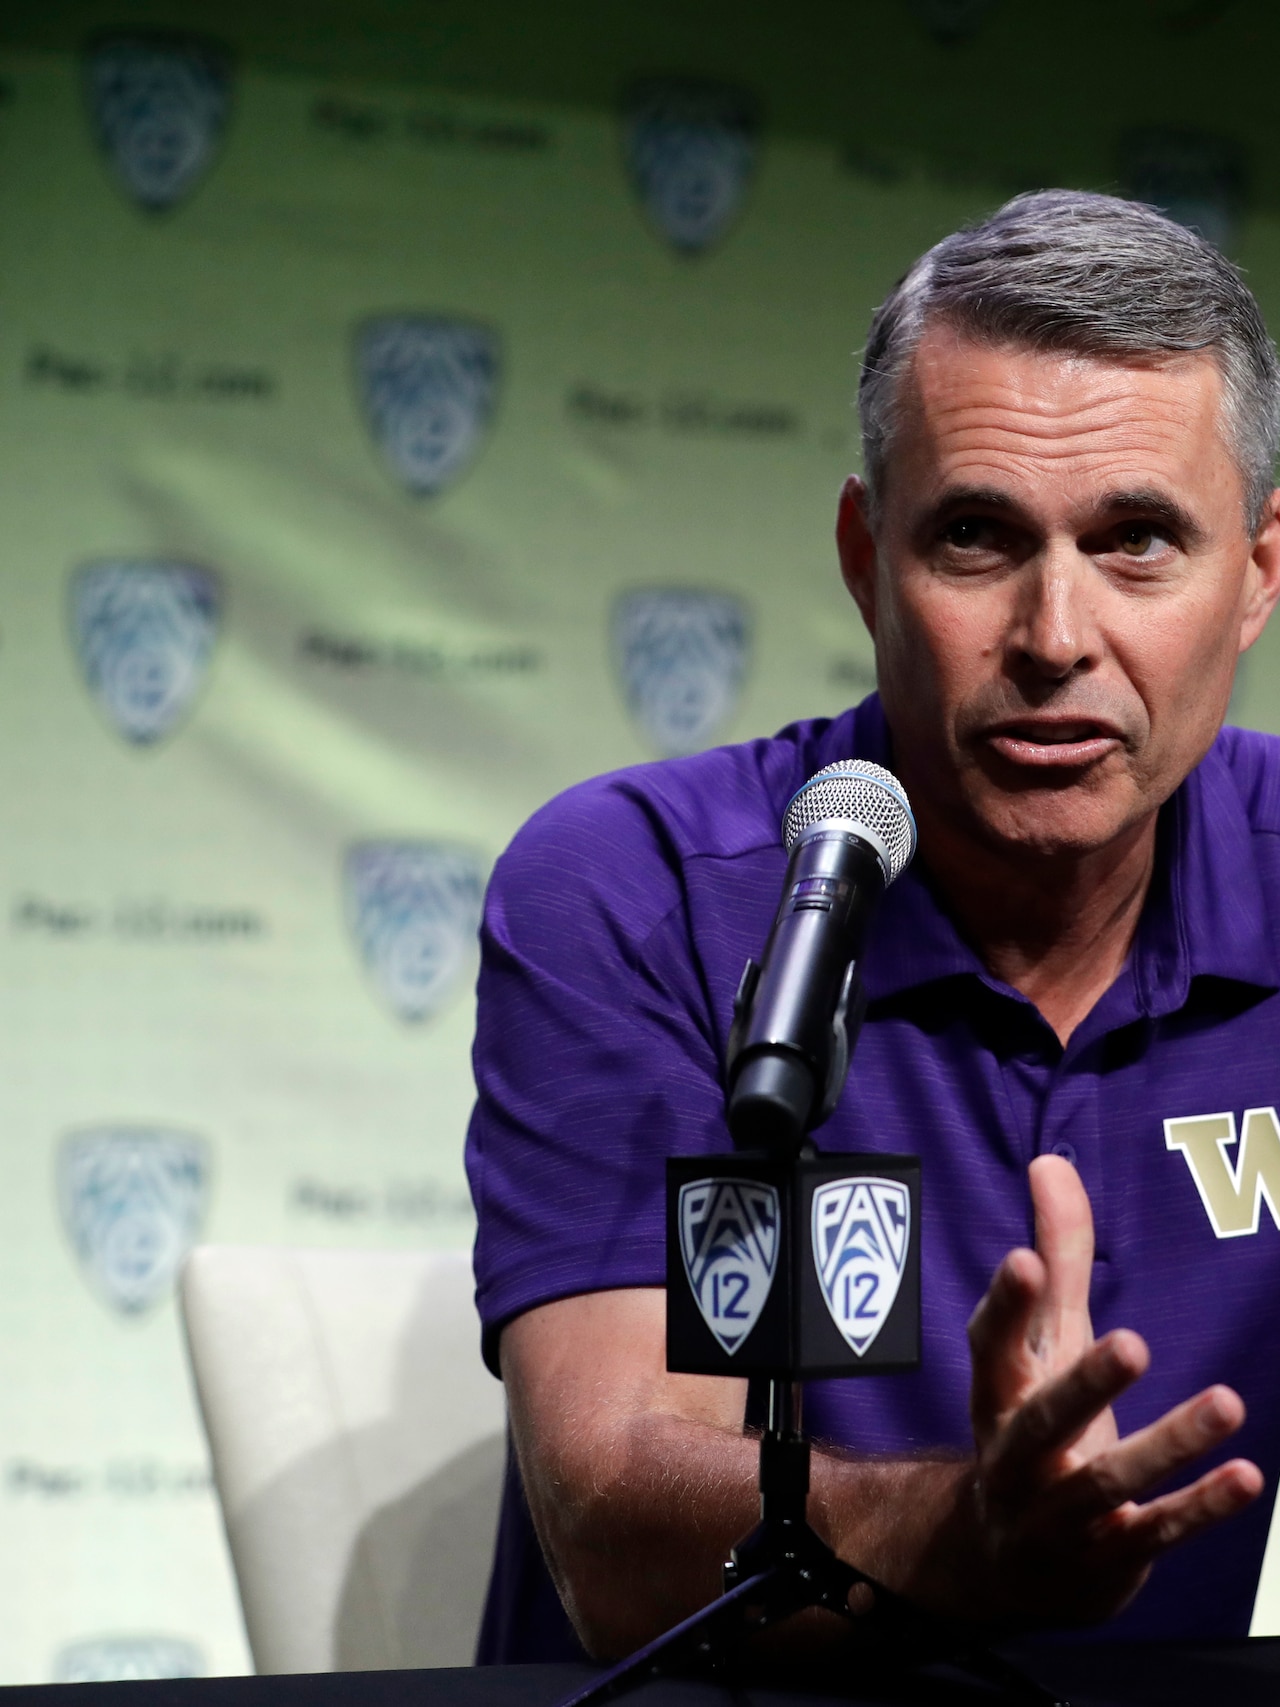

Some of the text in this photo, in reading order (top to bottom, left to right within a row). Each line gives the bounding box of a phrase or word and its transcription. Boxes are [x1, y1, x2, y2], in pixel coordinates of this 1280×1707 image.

[683, 1184, 775, 1277] PAC
[816, 1184, 906, 1277] PAC
[712, 1271, 751, 1319] 12
[843, 1271, 880, 1320] 12
